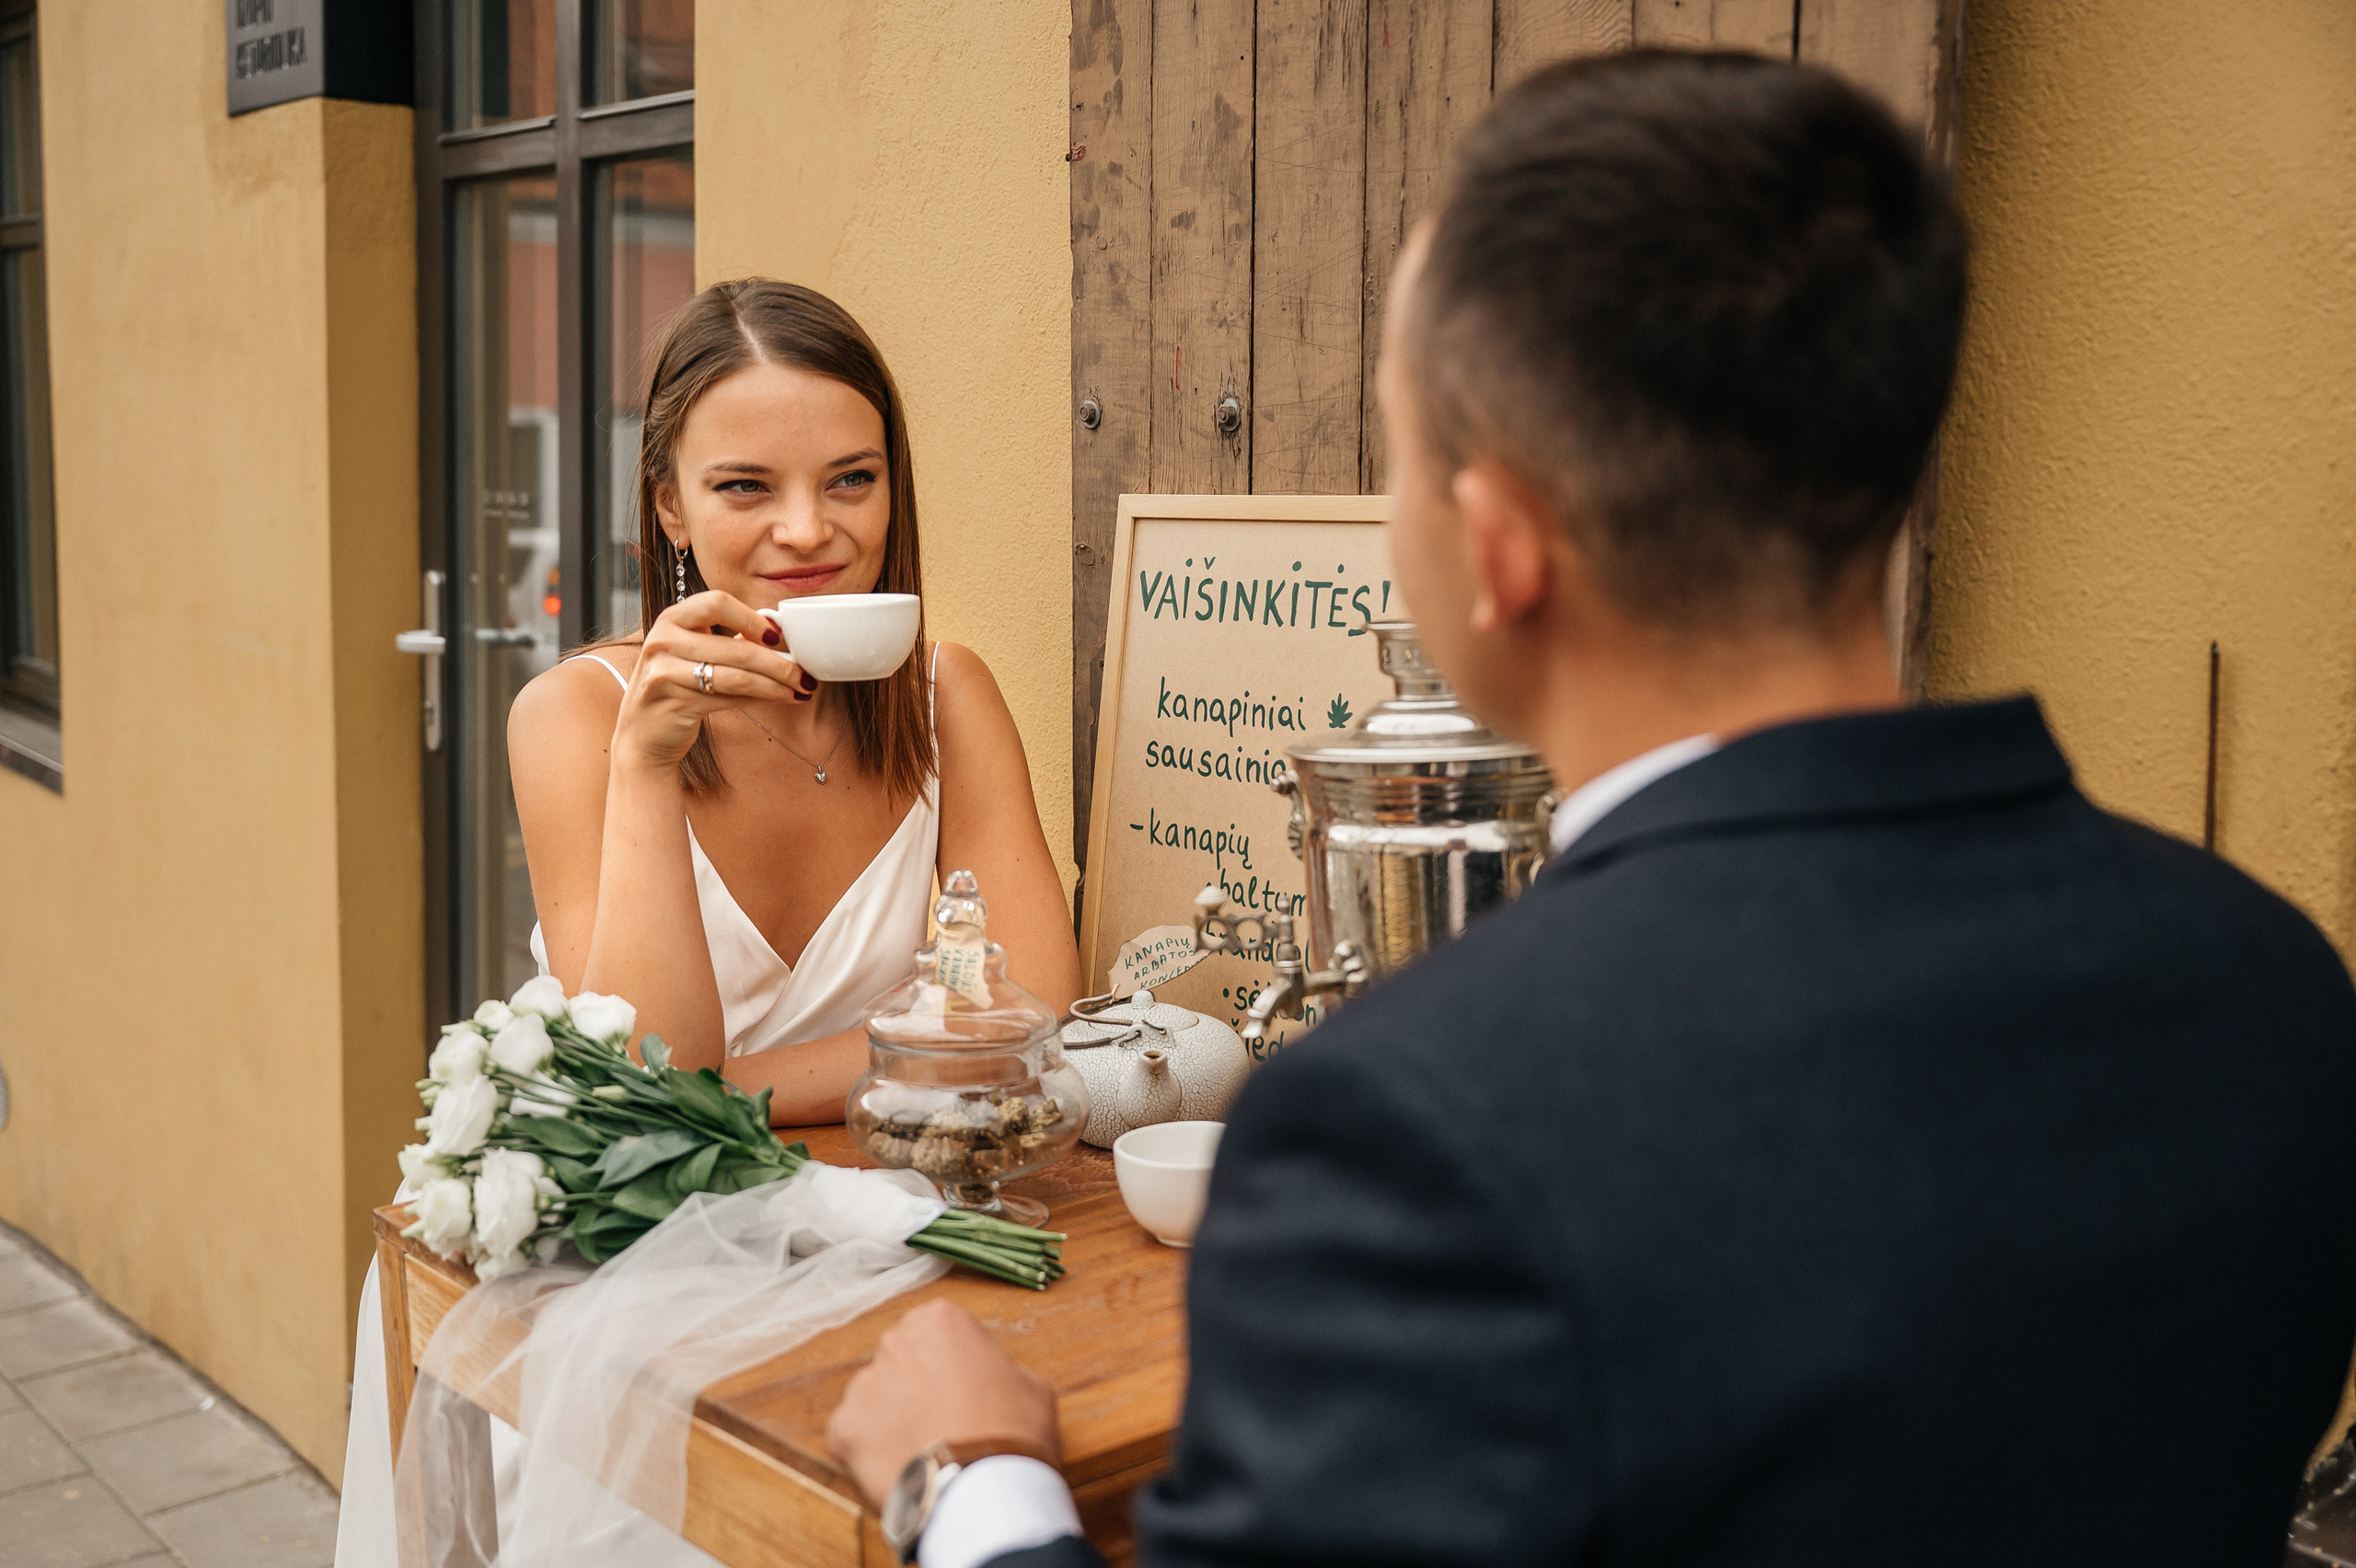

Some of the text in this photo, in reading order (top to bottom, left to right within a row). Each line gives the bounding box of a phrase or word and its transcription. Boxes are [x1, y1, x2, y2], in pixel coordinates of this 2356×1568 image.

[1157, 675, 1306, 738] kanapiniai
[1124, 937, 1193, 970] KANAPIŲ
[1134, 949, 1196, 981] ARBATOS
